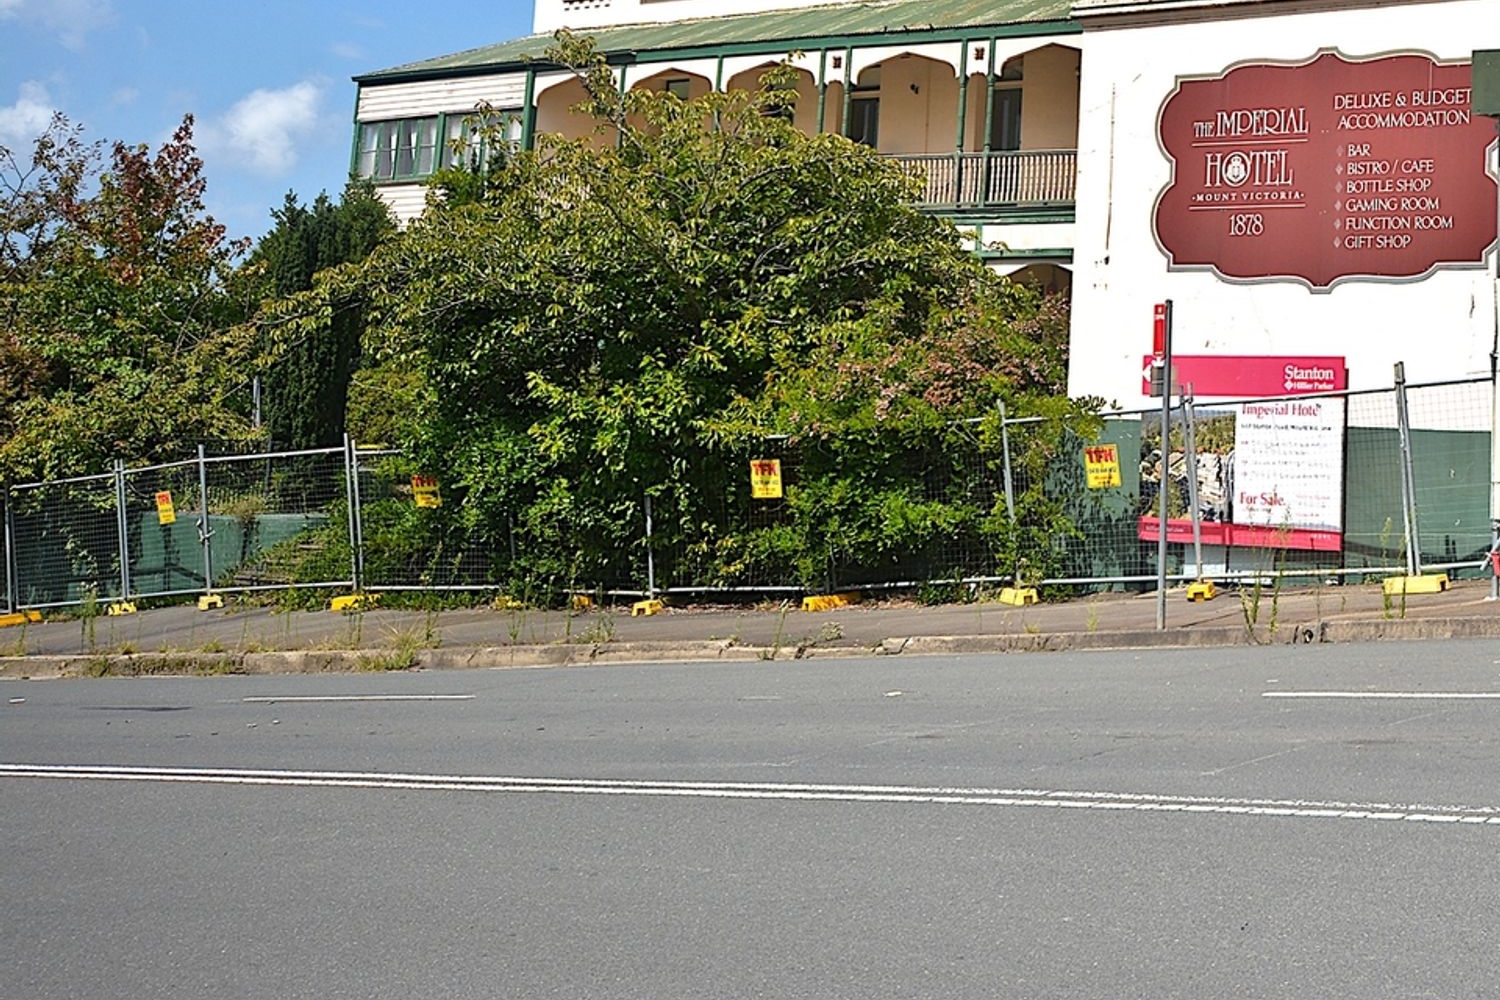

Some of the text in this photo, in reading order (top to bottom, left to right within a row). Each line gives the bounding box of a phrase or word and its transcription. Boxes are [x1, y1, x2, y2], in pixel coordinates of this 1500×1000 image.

[1334, 88, 1472, 109] DELUXE & BUDGET
[1194, 108, 1309, 137] THE IMPERIAL
[1337, 109, 1470, 130] ACCOMMODATION
[1348, 143, 1371, 157] BAR
[1204, 149, 1293, 187] HOTEL
[1347, 161, 1390, 175] BISTRO
[1401, 159, 1434, 173] CAFE
[1346, 178, 1431, 193] BOTTLE SHOP
[1196, 190, 1300, 201] MOUNT VICTORIA
[1346, 197, 1440, 212] GAMING ROOM
[1229, 214, 1264, 235] 1878
[1345, 215, 1453, 230] FUNCTION ROOM
[1344, 234, 1411, 248] GIFT SHOP
[1284, 364, 1334, 380] Stanton
[1242, 403, 1321, 419] Imperial Hote
[1240, 492, 1257, 504] For
